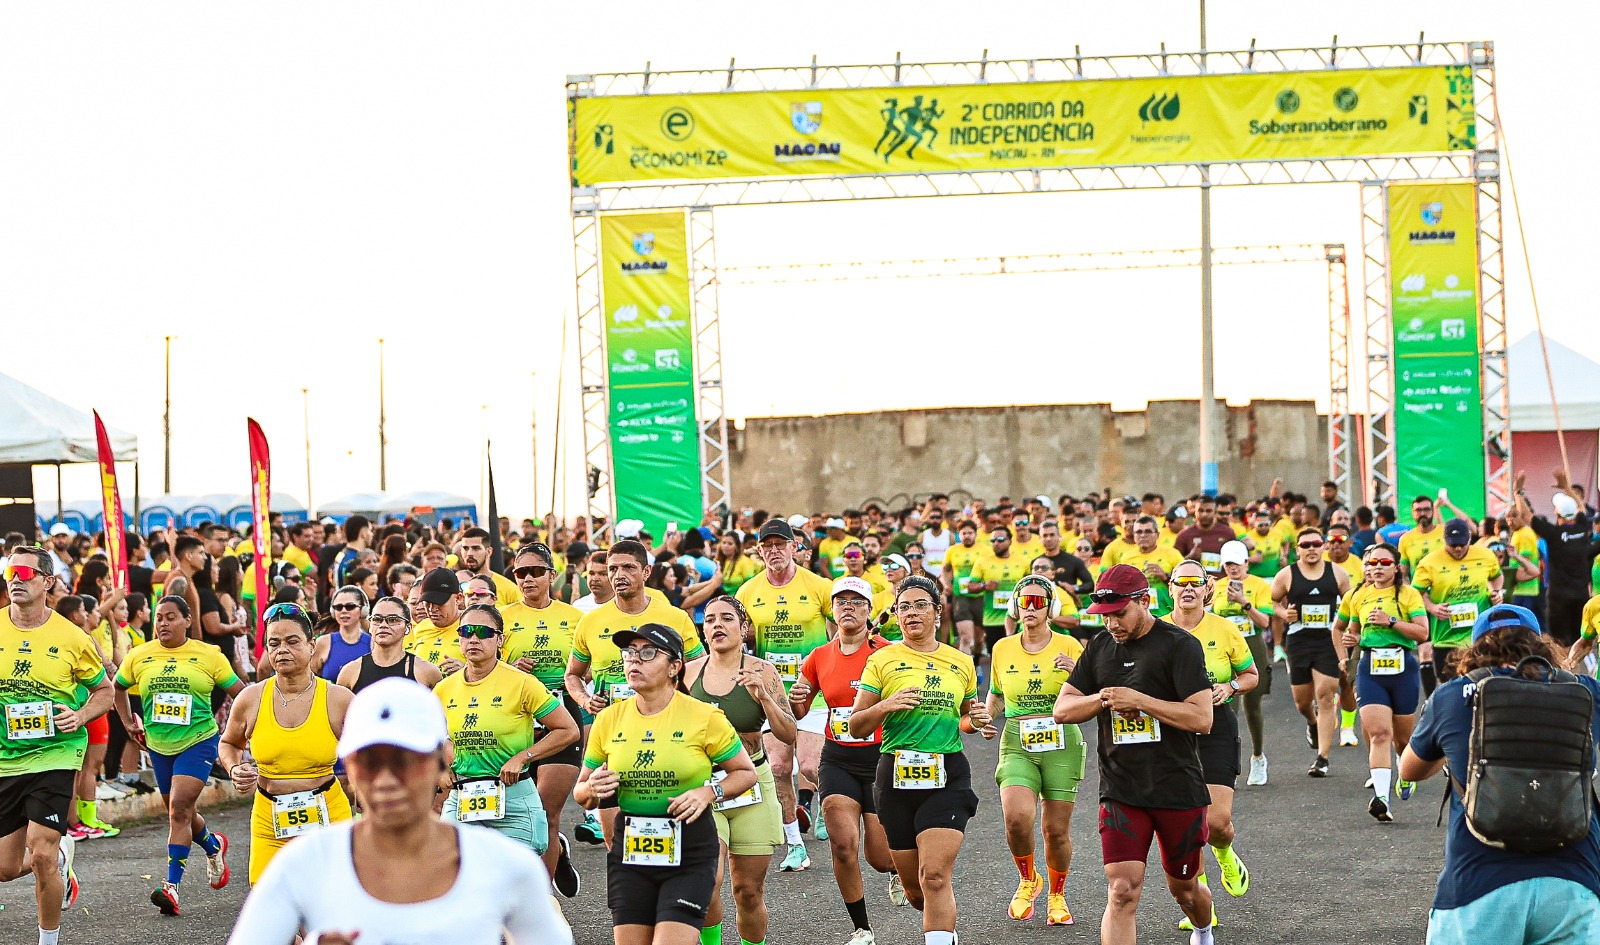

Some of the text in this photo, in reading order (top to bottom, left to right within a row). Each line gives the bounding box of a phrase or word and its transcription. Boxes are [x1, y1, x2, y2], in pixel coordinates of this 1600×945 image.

[982, 101, 1055, 122] CORRIDA
[1061, 100, 1085, 118] DA
[774, 142, 842, 156] MACAU
[1307, 614, 1324, 622] 312
[1376, 659, 1395, 668] 112
[159, 704, 181, 716] 128
[15, 717, 41, 730] 156
[1119, 718, 1146, 733] 159
[1028, 731, 1053, 744] 224
[628, 770, 661, 779] CORRIDA
[663, 770, 675, 778] DA
[903, 766, 931, 779] 155
[468, 797, 487, 811] 33
[287, 809, 309, 825] 55
[633, 837, 665, 853] 125
